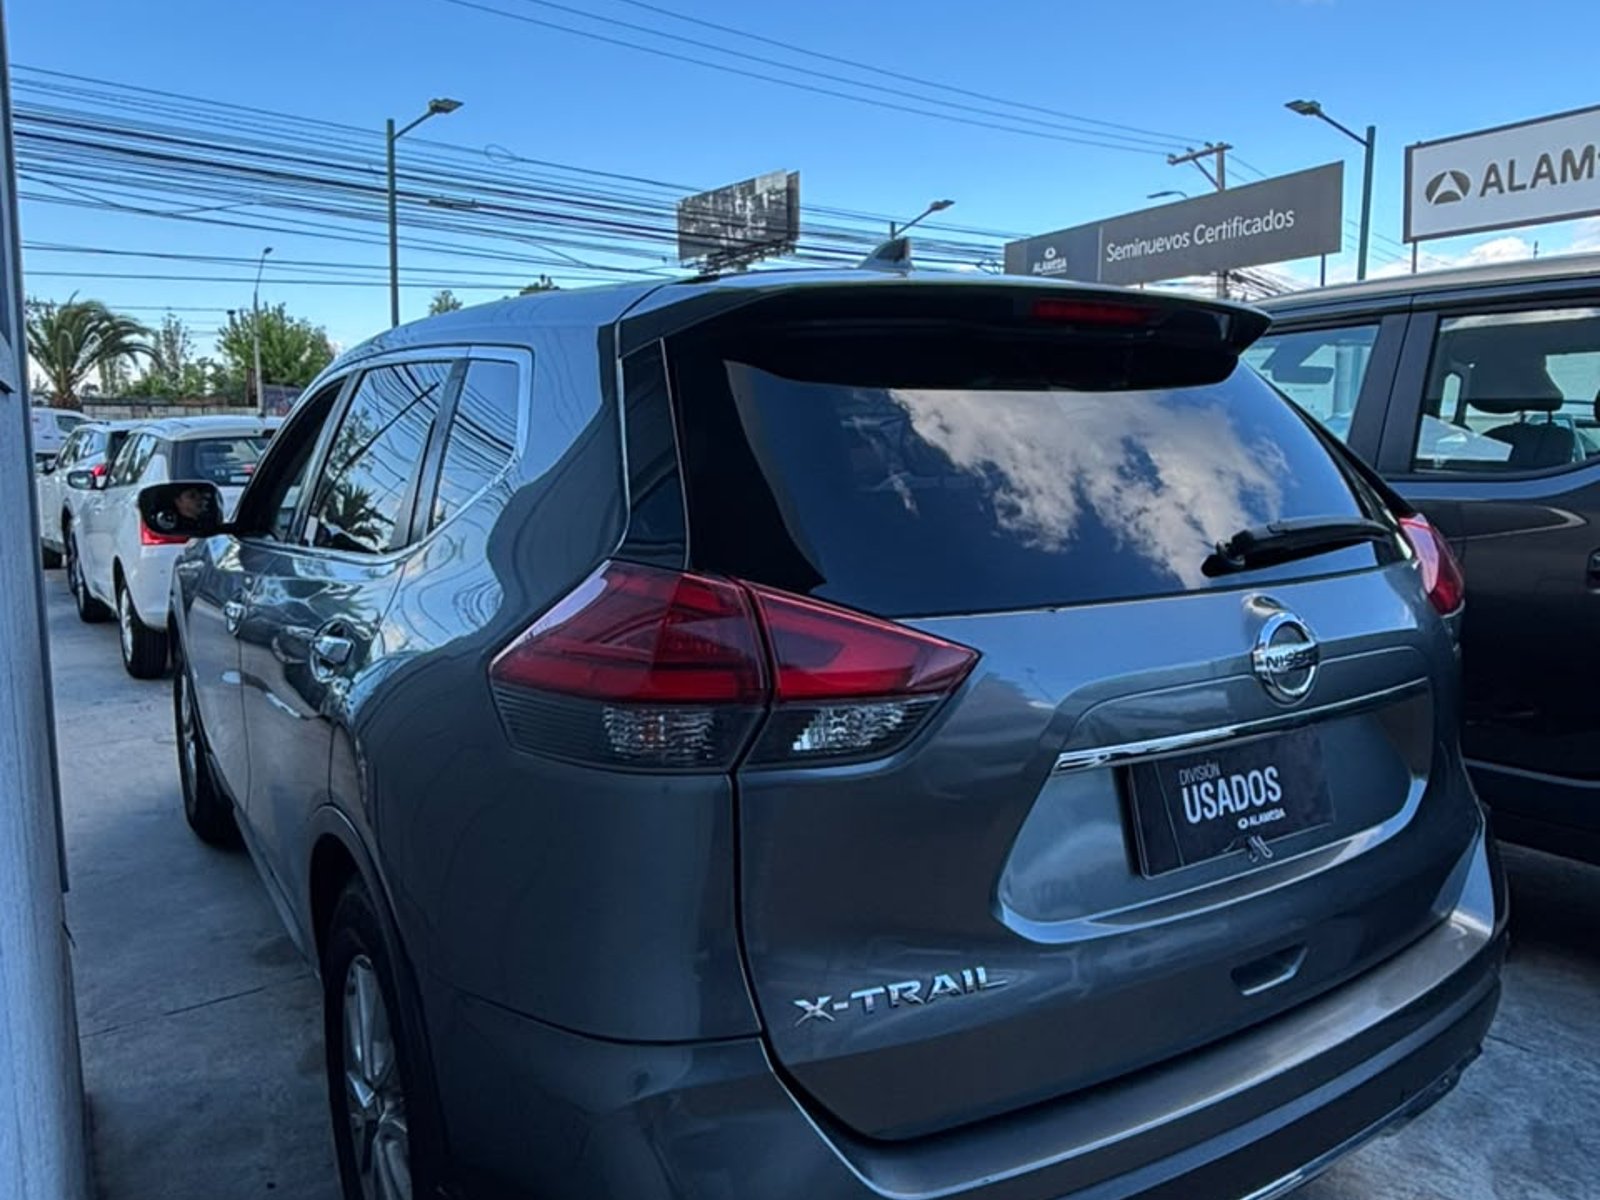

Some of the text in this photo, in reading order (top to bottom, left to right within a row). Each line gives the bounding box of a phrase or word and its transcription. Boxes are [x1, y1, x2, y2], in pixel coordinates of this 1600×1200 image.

[1479, 144, 1600, 197] ALAM
[1106, 209, 1295, 262] Seminuevos Certificados
[1179, 759, 1221, 785] DIVISIÓN
[1182, 766, 1282, 824] USADOS
[1248, 808, 1286, 826] ALAMEDA
[794, 966, 1008, 1026] X-TRAIL
